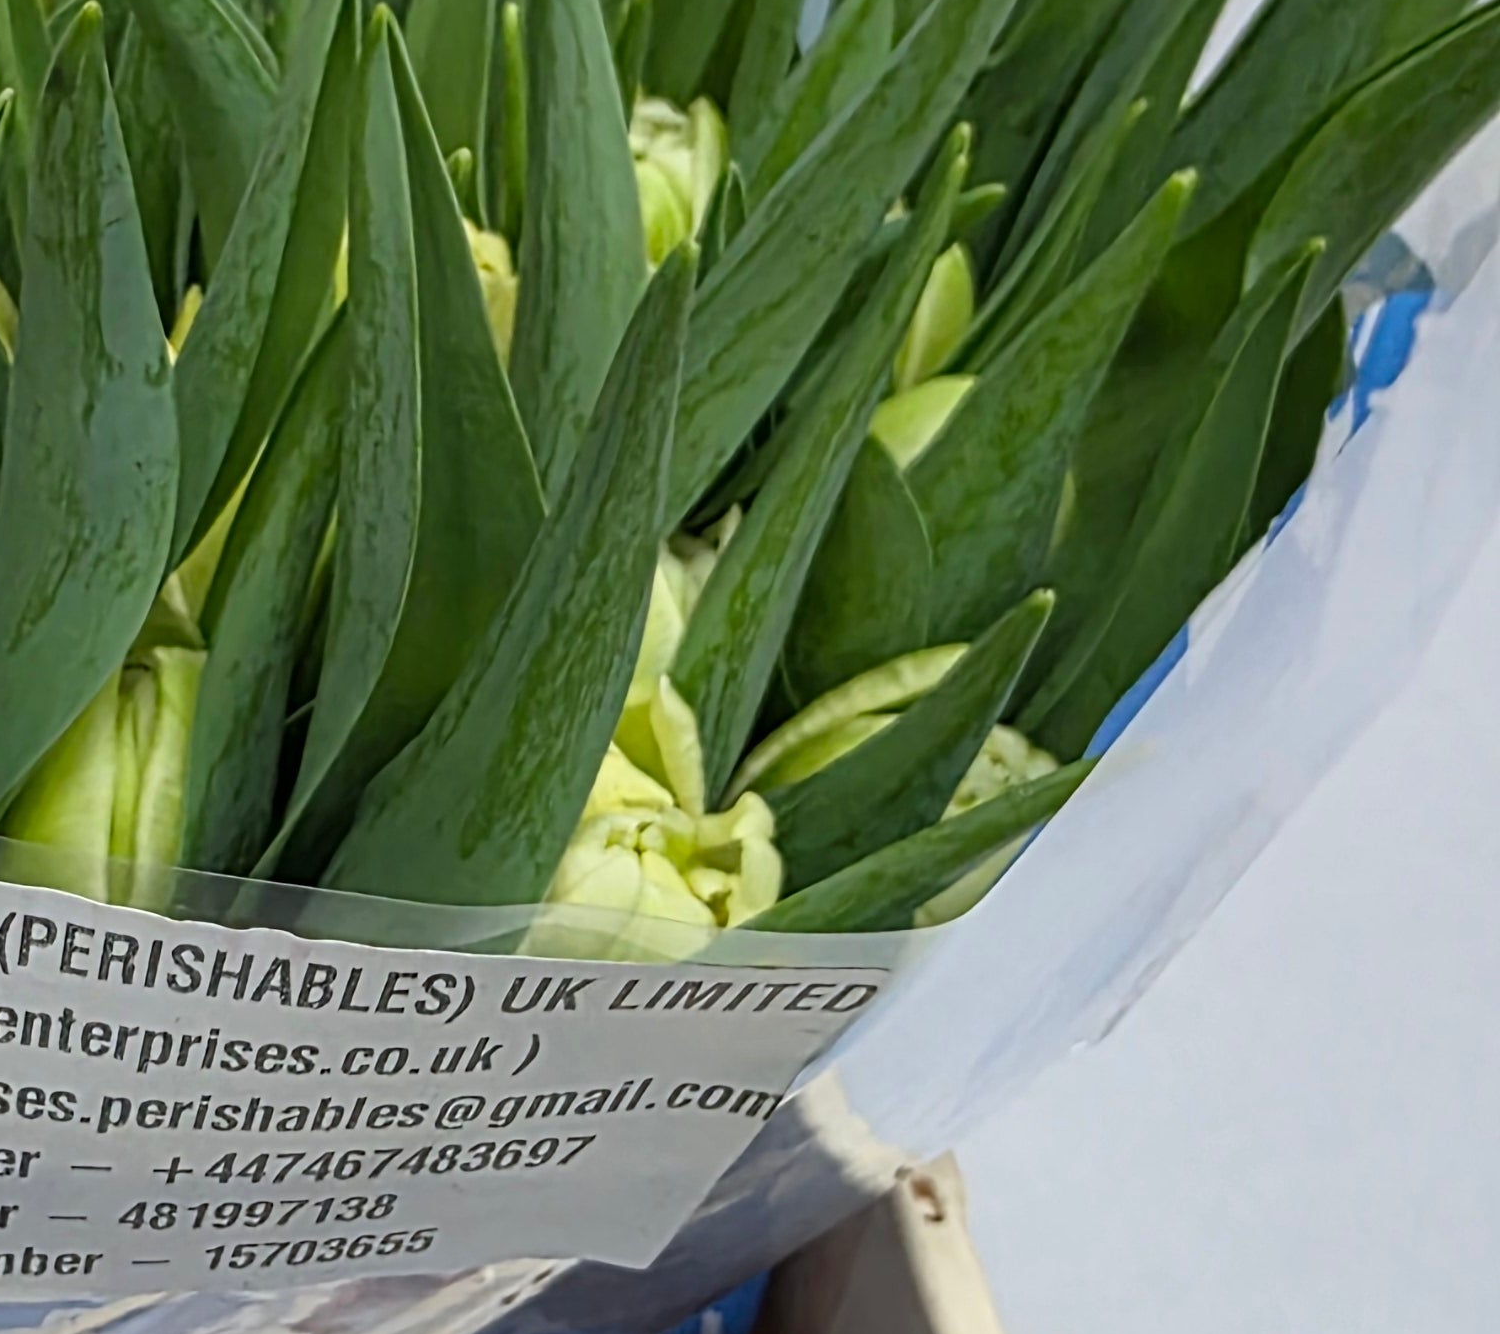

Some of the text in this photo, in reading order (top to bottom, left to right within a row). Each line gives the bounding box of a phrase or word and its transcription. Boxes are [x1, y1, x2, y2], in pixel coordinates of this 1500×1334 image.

[501, 976, 598, 1014] UK
[608, 978, 879, 1013] LIMITED
[152, 1134, 597, 1185] +447467483697
[118, 1193, 398, 1231] 481997138
[205, 1227, 438, 1272] 15703655
